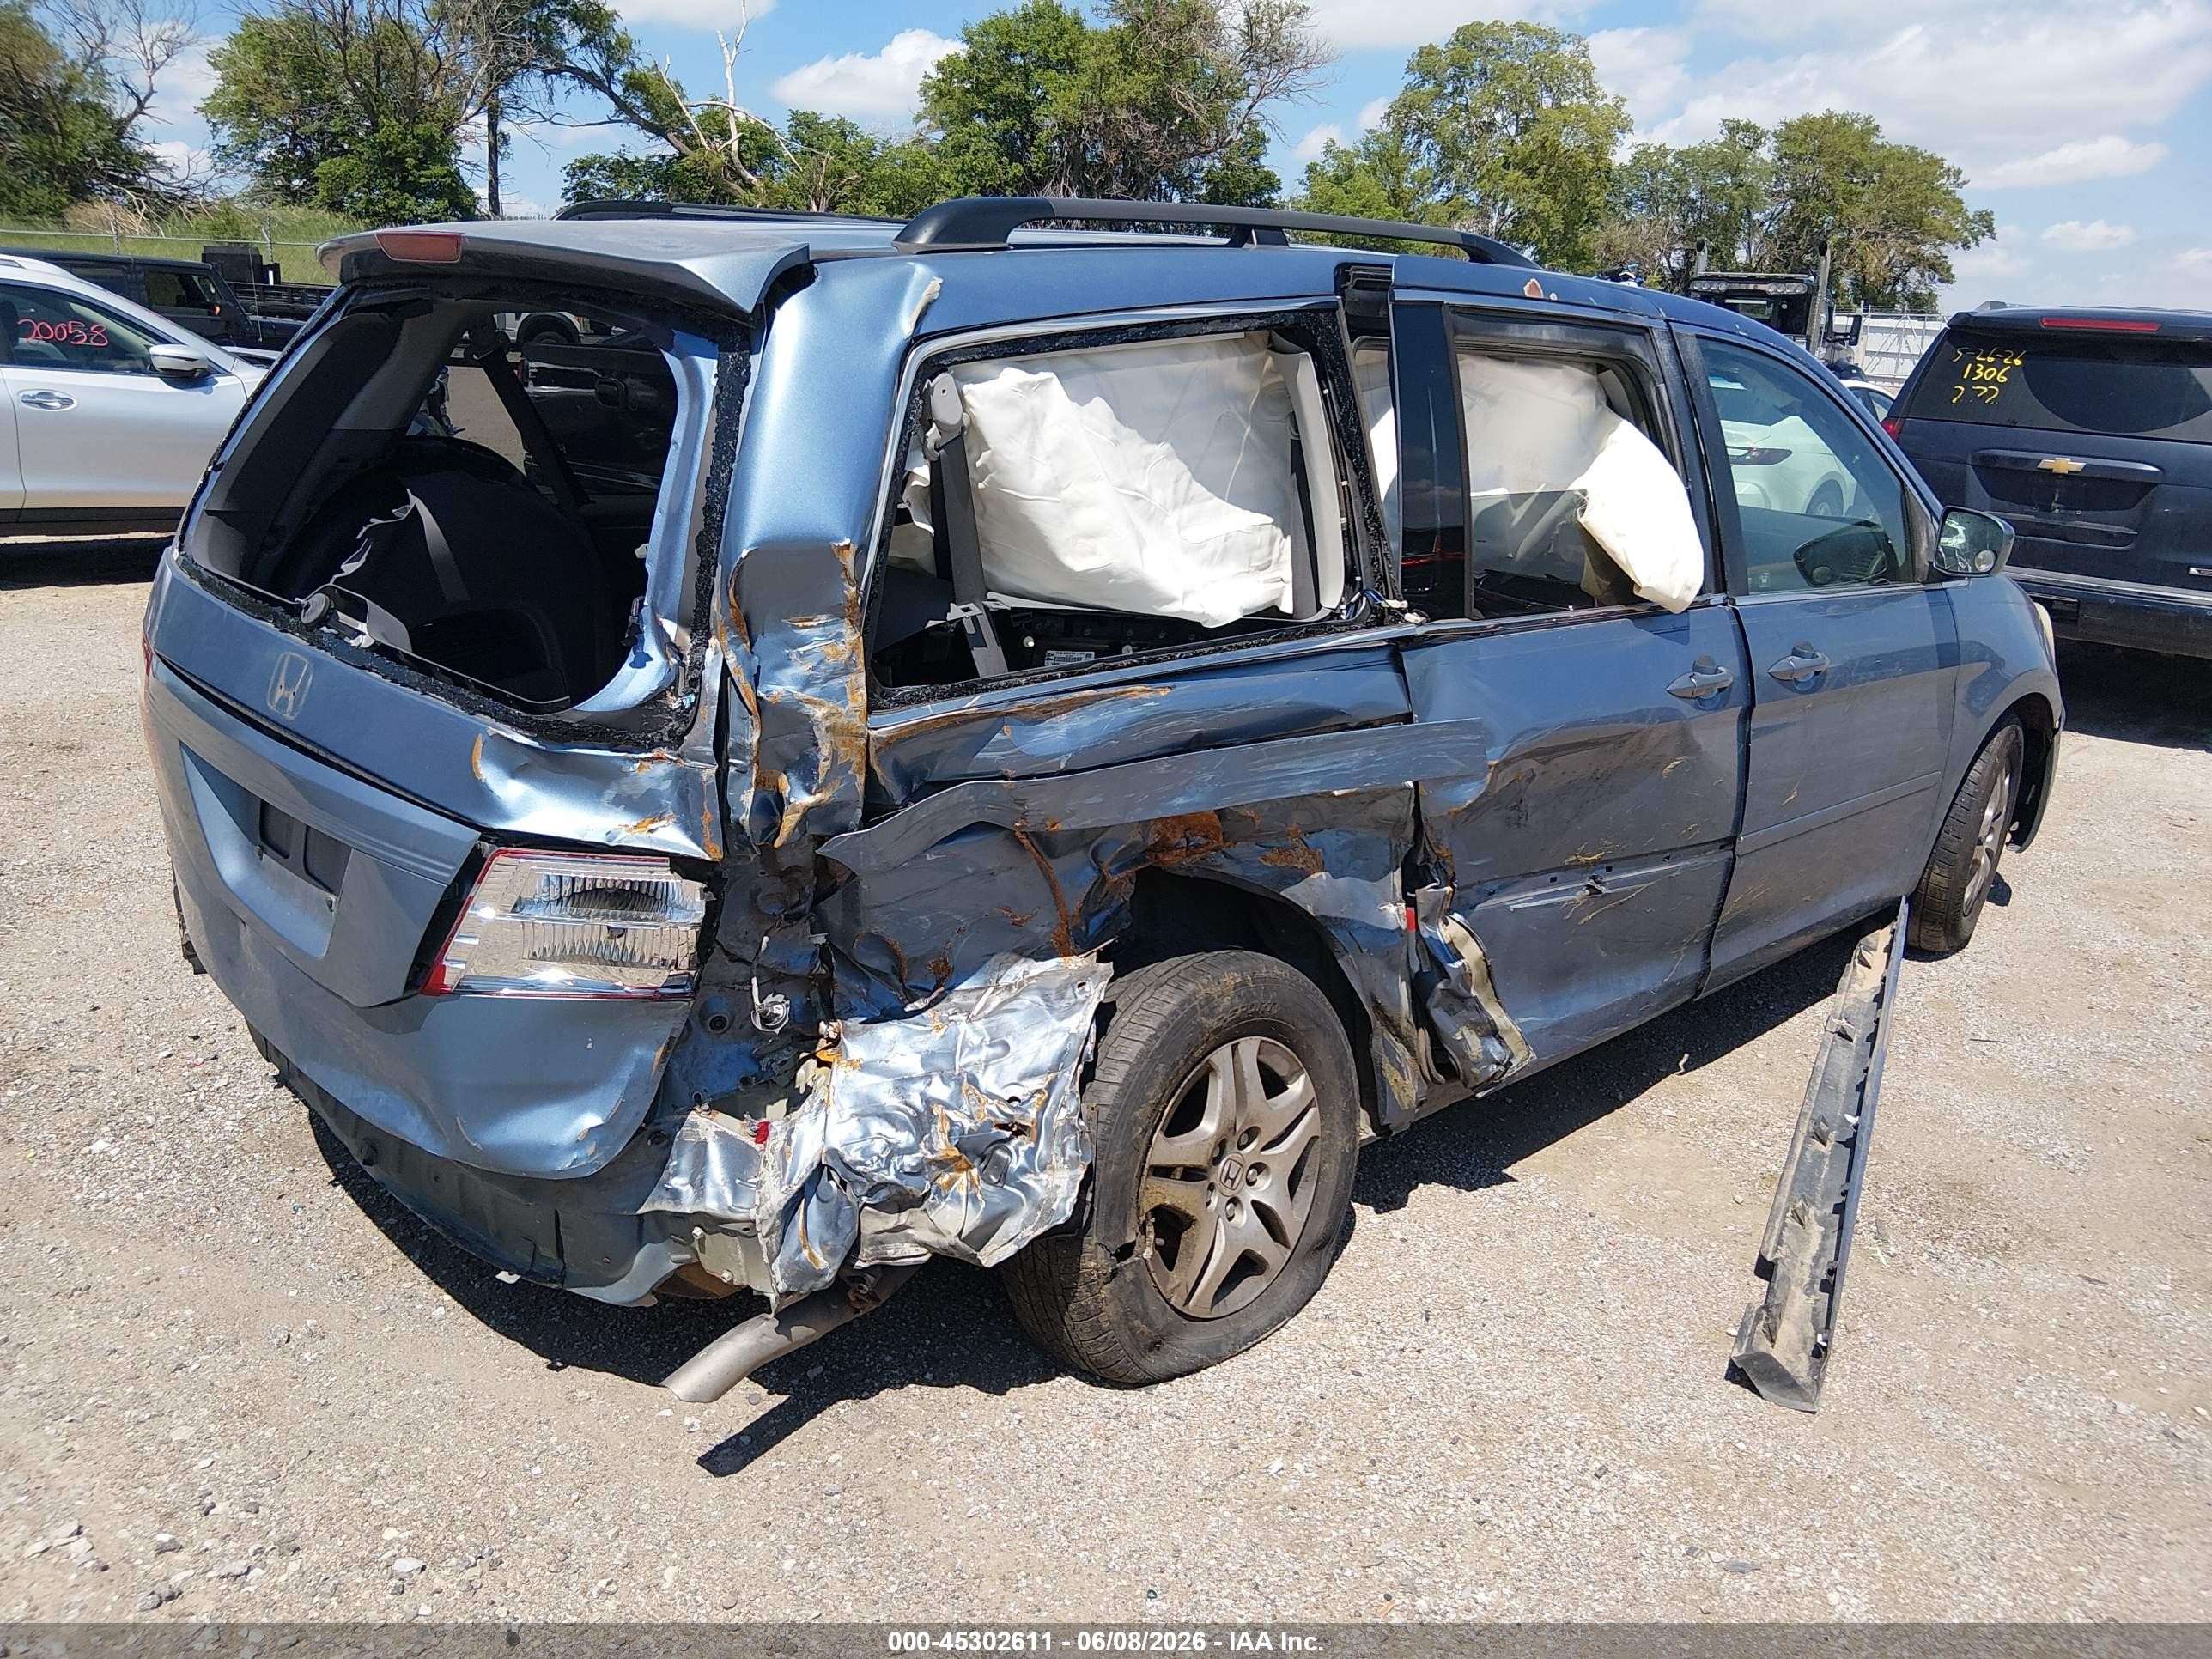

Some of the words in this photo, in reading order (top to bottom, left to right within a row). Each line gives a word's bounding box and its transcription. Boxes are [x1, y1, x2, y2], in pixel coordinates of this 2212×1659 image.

[17, 319, 109, 347] 20058
[1952, 347, 2027, 366] 5-26-26
[1963, 363, 2011, 383] 1306
